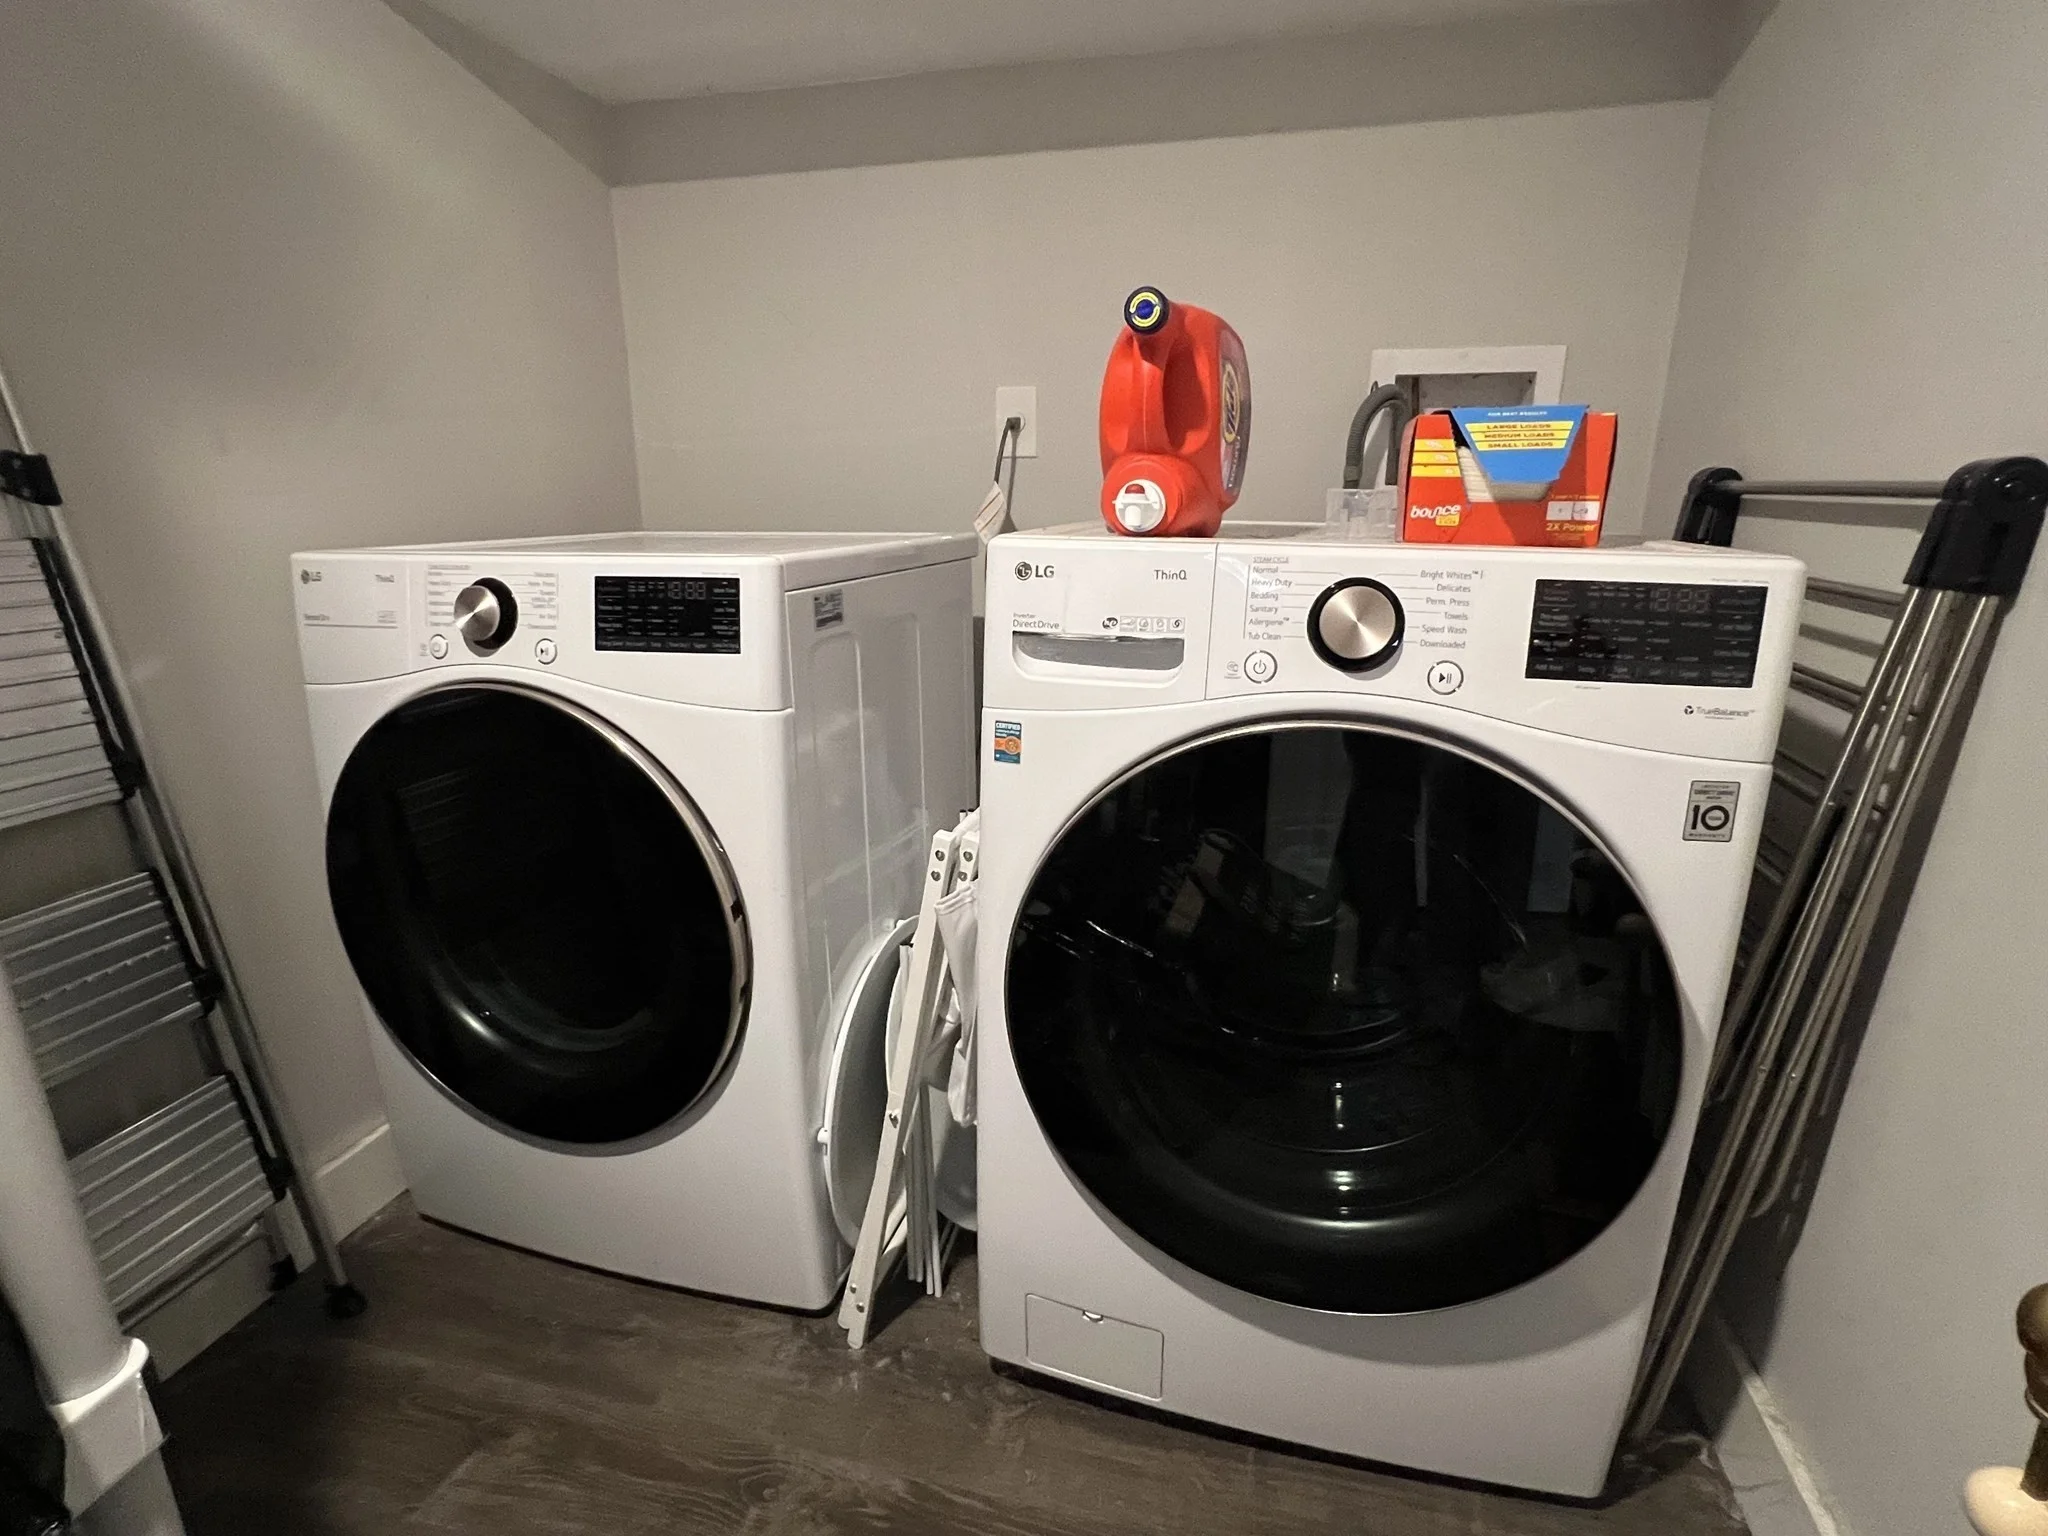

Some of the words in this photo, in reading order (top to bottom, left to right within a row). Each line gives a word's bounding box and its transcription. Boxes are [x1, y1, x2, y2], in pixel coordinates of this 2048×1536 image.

[1410, 505, 1461, 519] bounce
[1546, 522, 1560, 531] 2X
[1035, 565, 1055, 578] LG
[1154, 569, 1188, 581] ThinQ
[1420, 569, 1444, 580] Bright
[1251, 579, 1273, 587] Heavy
[1275, 578, 1293, 588] Duty
[1436, 583, 1471, 592] Delicates
[1449, 598, 1470, 607] Press
[1249, 604, 1278, 614] Sanitary
[1443, 611, 1468, 620] Towels
[1422, 624, 1445, 634] Speed
[1447, 626, 1467, 635] Wash
[1248, 631, 1260, 640] Tub
[1261, 632, 1281, 640] Clean
[1420, 639, 1466, 649] Downloaded
[1691, 804, 1730, 831] 10
